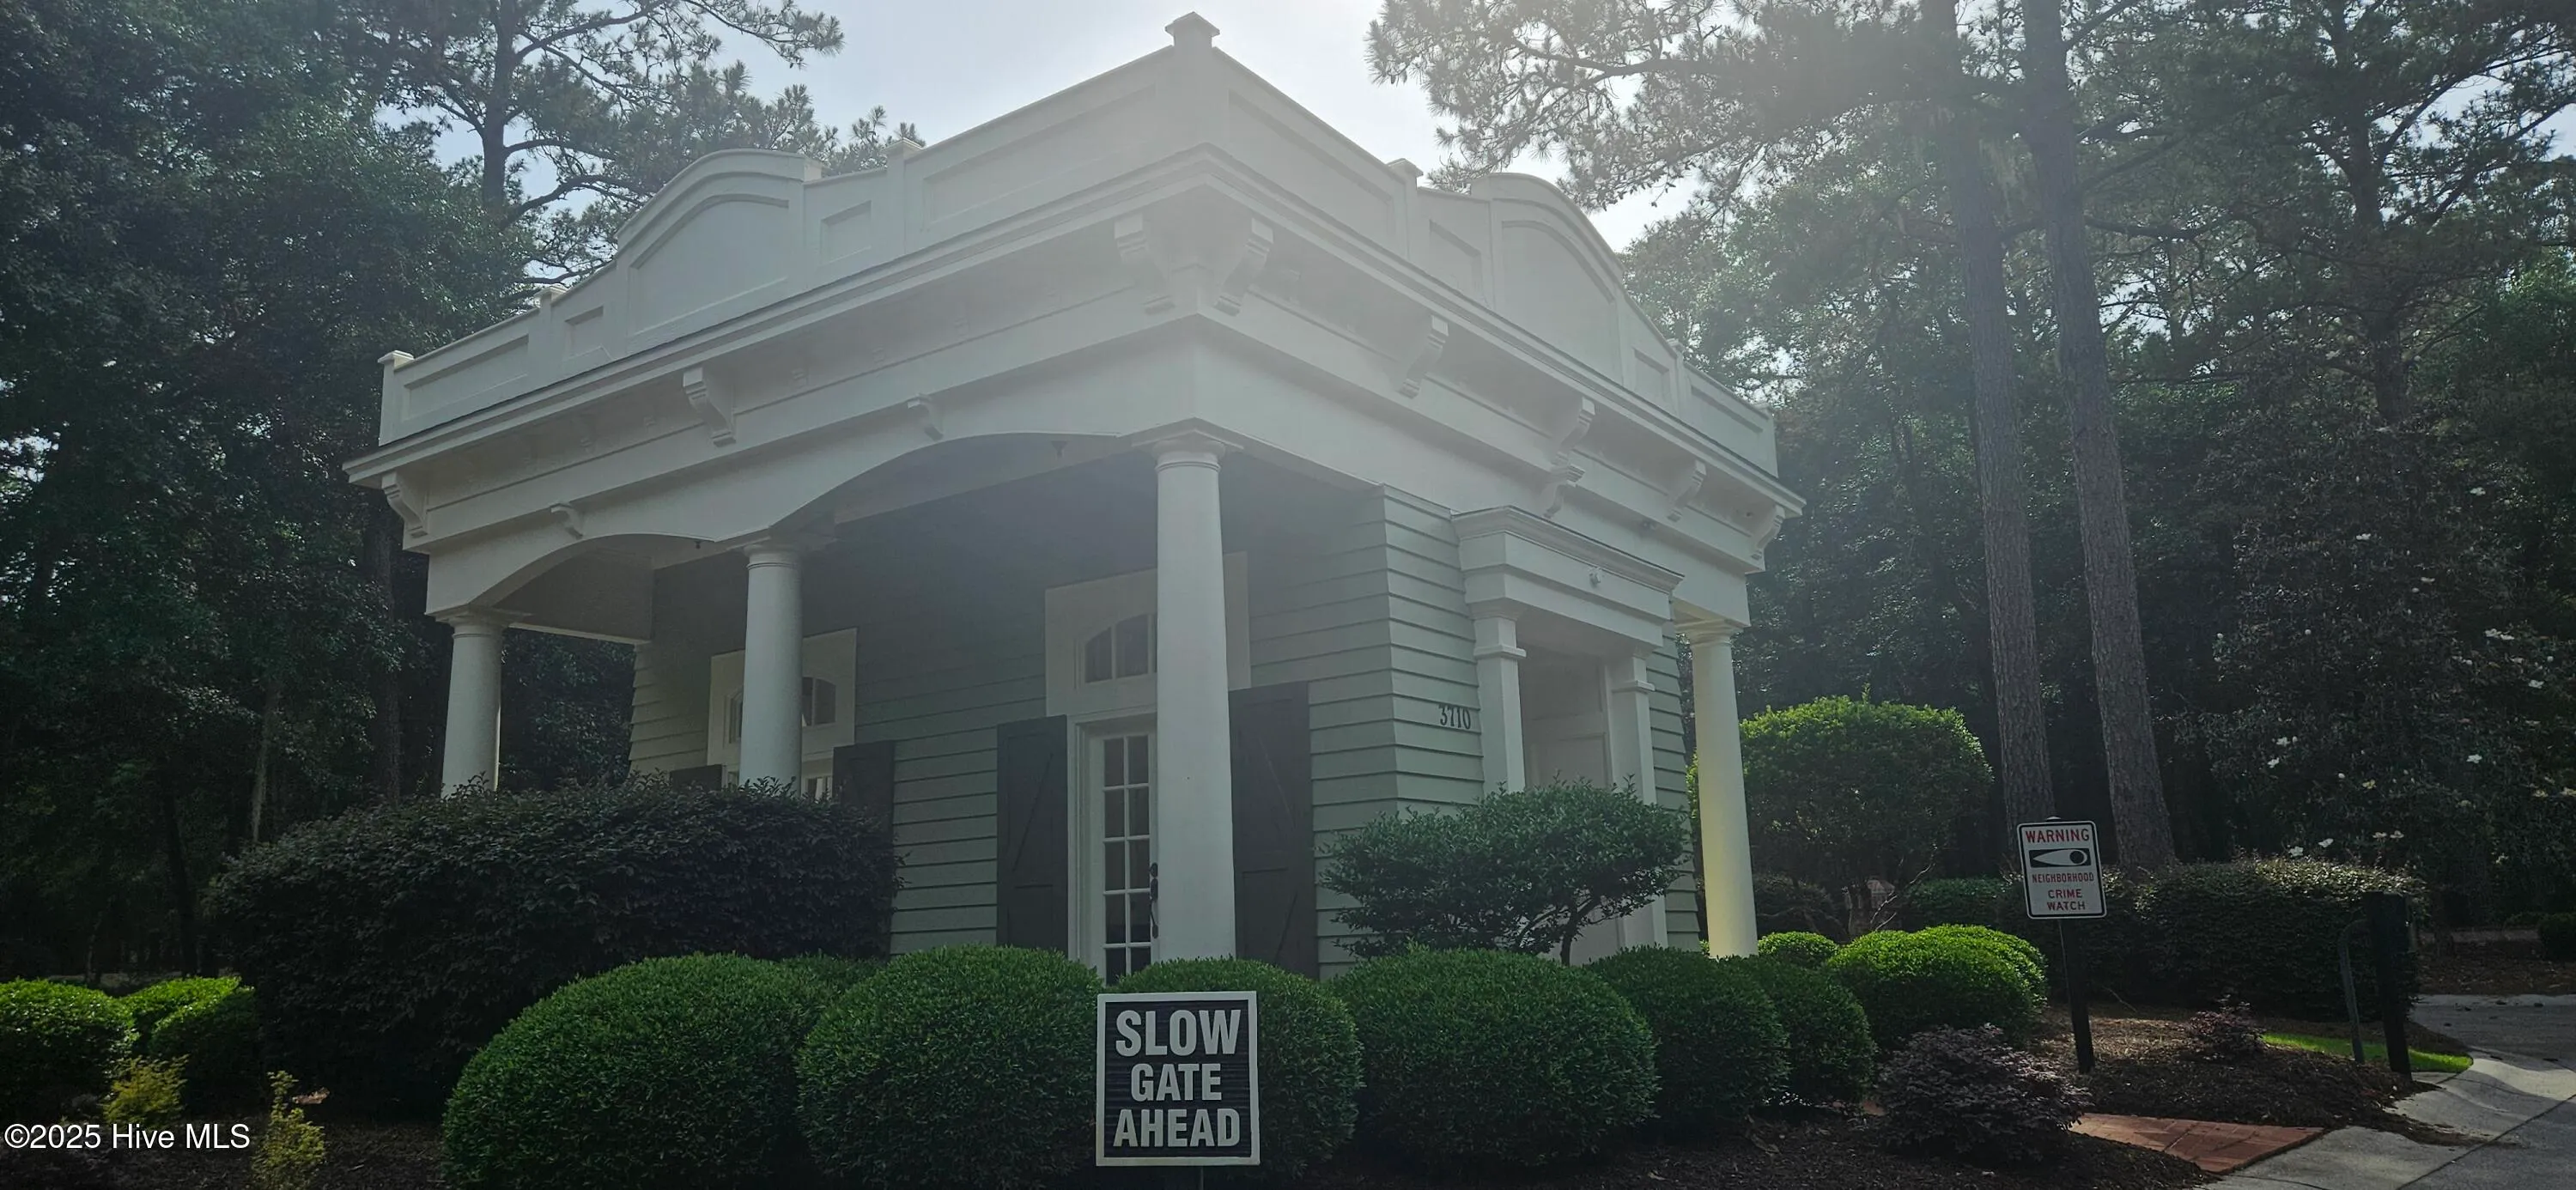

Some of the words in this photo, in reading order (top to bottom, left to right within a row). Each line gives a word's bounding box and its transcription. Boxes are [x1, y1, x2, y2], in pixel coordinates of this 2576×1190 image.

[2026, 829, 2090, 843] WARNING
[2032, 872, 2094, 883] NEIGHBORHOOD
[2048, 889, 2082, 899] CRIME
[2046, 901, 2086, 911] WATCH
[1115, 1009, 1242, 1057] SLOW
[1130, 1063, 1223, 1102] GATE
[1112, 1108, 1241, 1148] AHEAD
